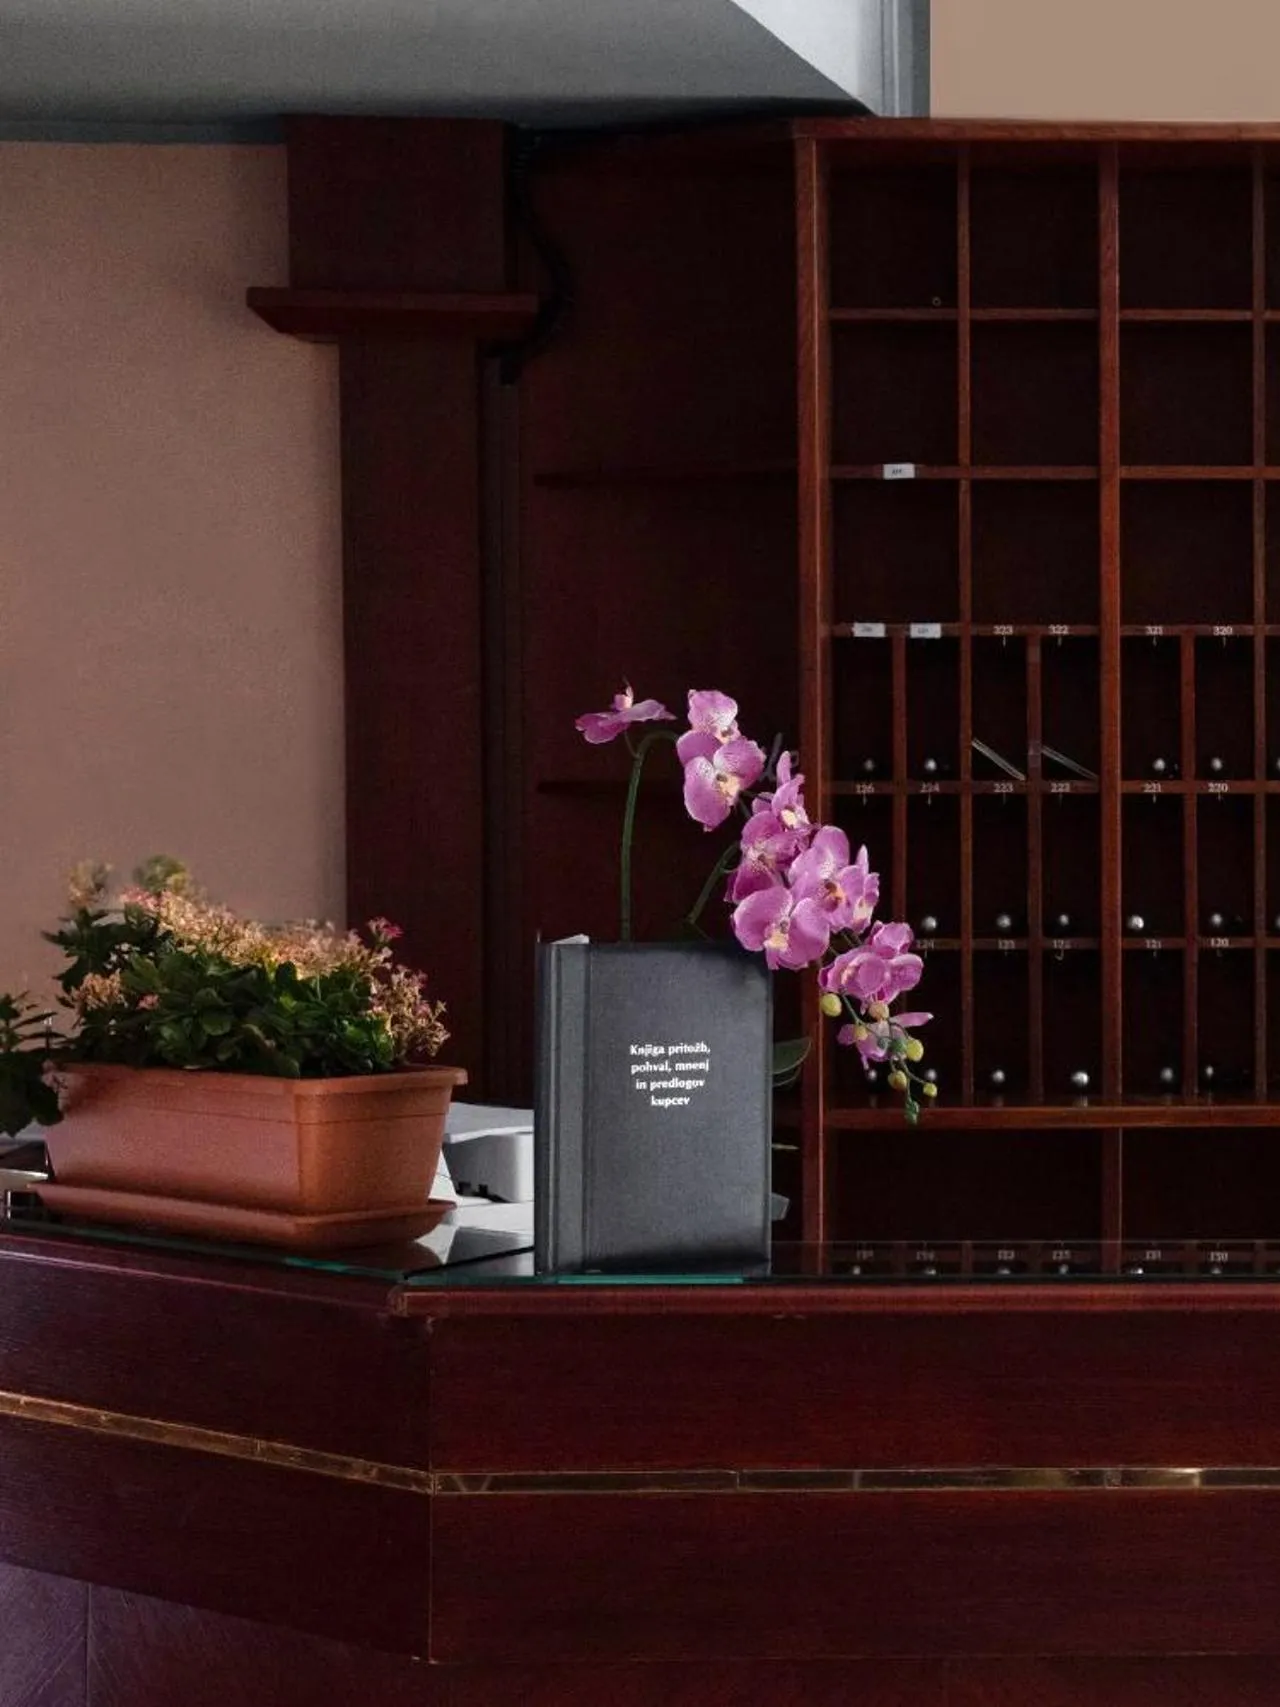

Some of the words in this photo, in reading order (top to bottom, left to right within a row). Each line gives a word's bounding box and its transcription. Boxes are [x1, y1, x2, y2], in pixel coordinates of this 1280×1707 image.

[993, 782, 1014, 793] 223
[629, 1043, 666, 1057] Knjiga
[668, 1041, 711, 1057] pritožb,
[630, 1060, 672, 1075] pohval,
[675, 1059, 710, 1072] mnenj
[635, 1078, 647, 1090] in
[649, 1077, 706, 1091] predlogov
[650, 1095, 691, 1108] kupcev
